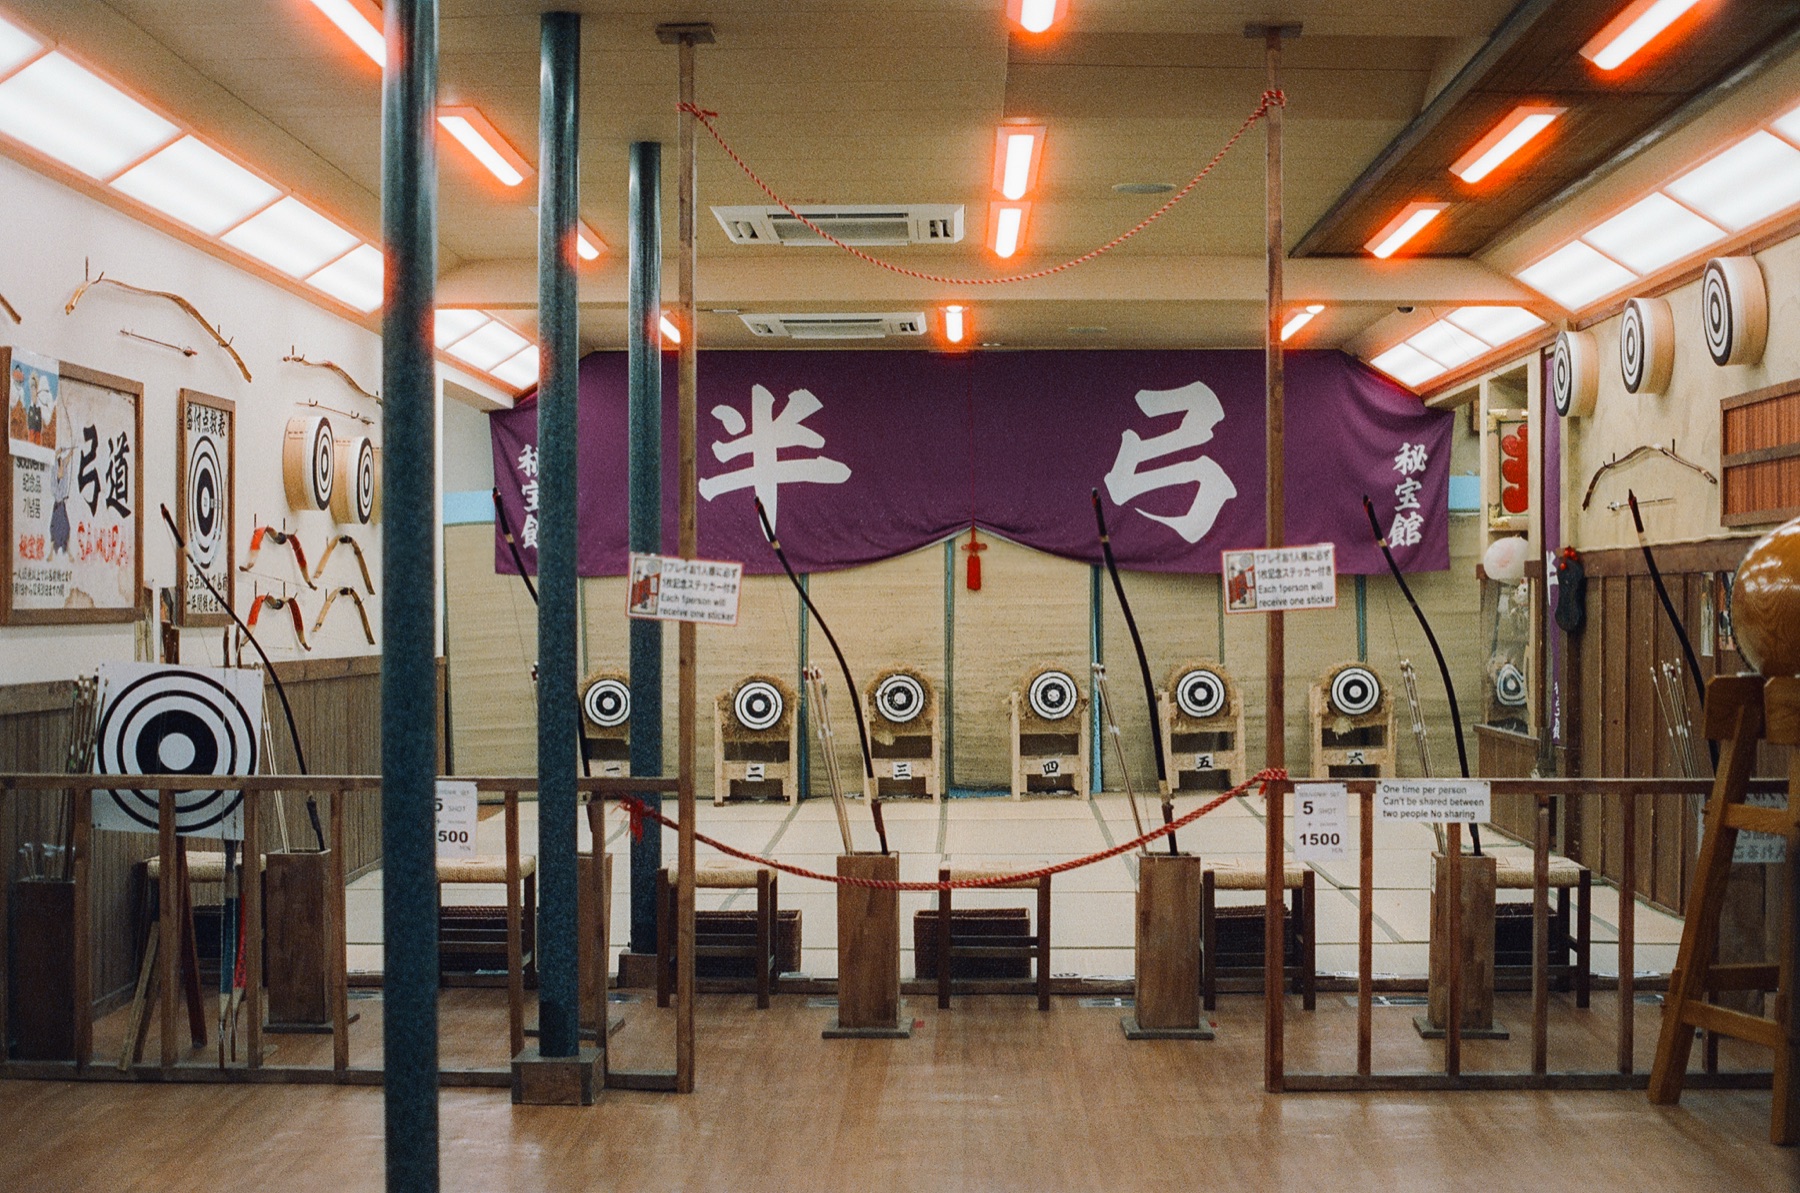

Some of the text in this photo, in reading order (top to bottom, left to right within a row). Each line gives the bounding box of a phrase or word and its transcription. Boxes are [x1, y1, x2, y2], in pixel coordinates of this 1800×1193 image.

[698, 381, 1237, 543] 半 弓
[78, 424, 132, 519] 弓道
[1388, 442, 1428, 549] 秘宝館
[1258, 582, 1323, 594] Each 1person will
[661, 593, 680, 602] Each
[714, 598, 727, 606] will
[1259, 598, 1287, 607] receive
[1307, 595, 1333, 604] sticker
[660, 607, 688, 617] receive
[708, 612, 735, 621] sticker
[1197, 755, 1213, 769] 五
[1347, 752, 1364, 765] 六
[748, 766, 763, 779] 二
[894, 763, 911, 779] 三
[1042, 761, 1060, 775] 四
[1383, 784, 1467, 795] One time per person
[1303, 801, 1314, 815] 5
[1383, 797, 1484, 806] Can't be shared between
[1400, 810, 1428, 819] people
[1444, 810, 1475, 820] sharing
[438, 831, 468, 843] 500
[1299, 833, 1340, 846] 1500
